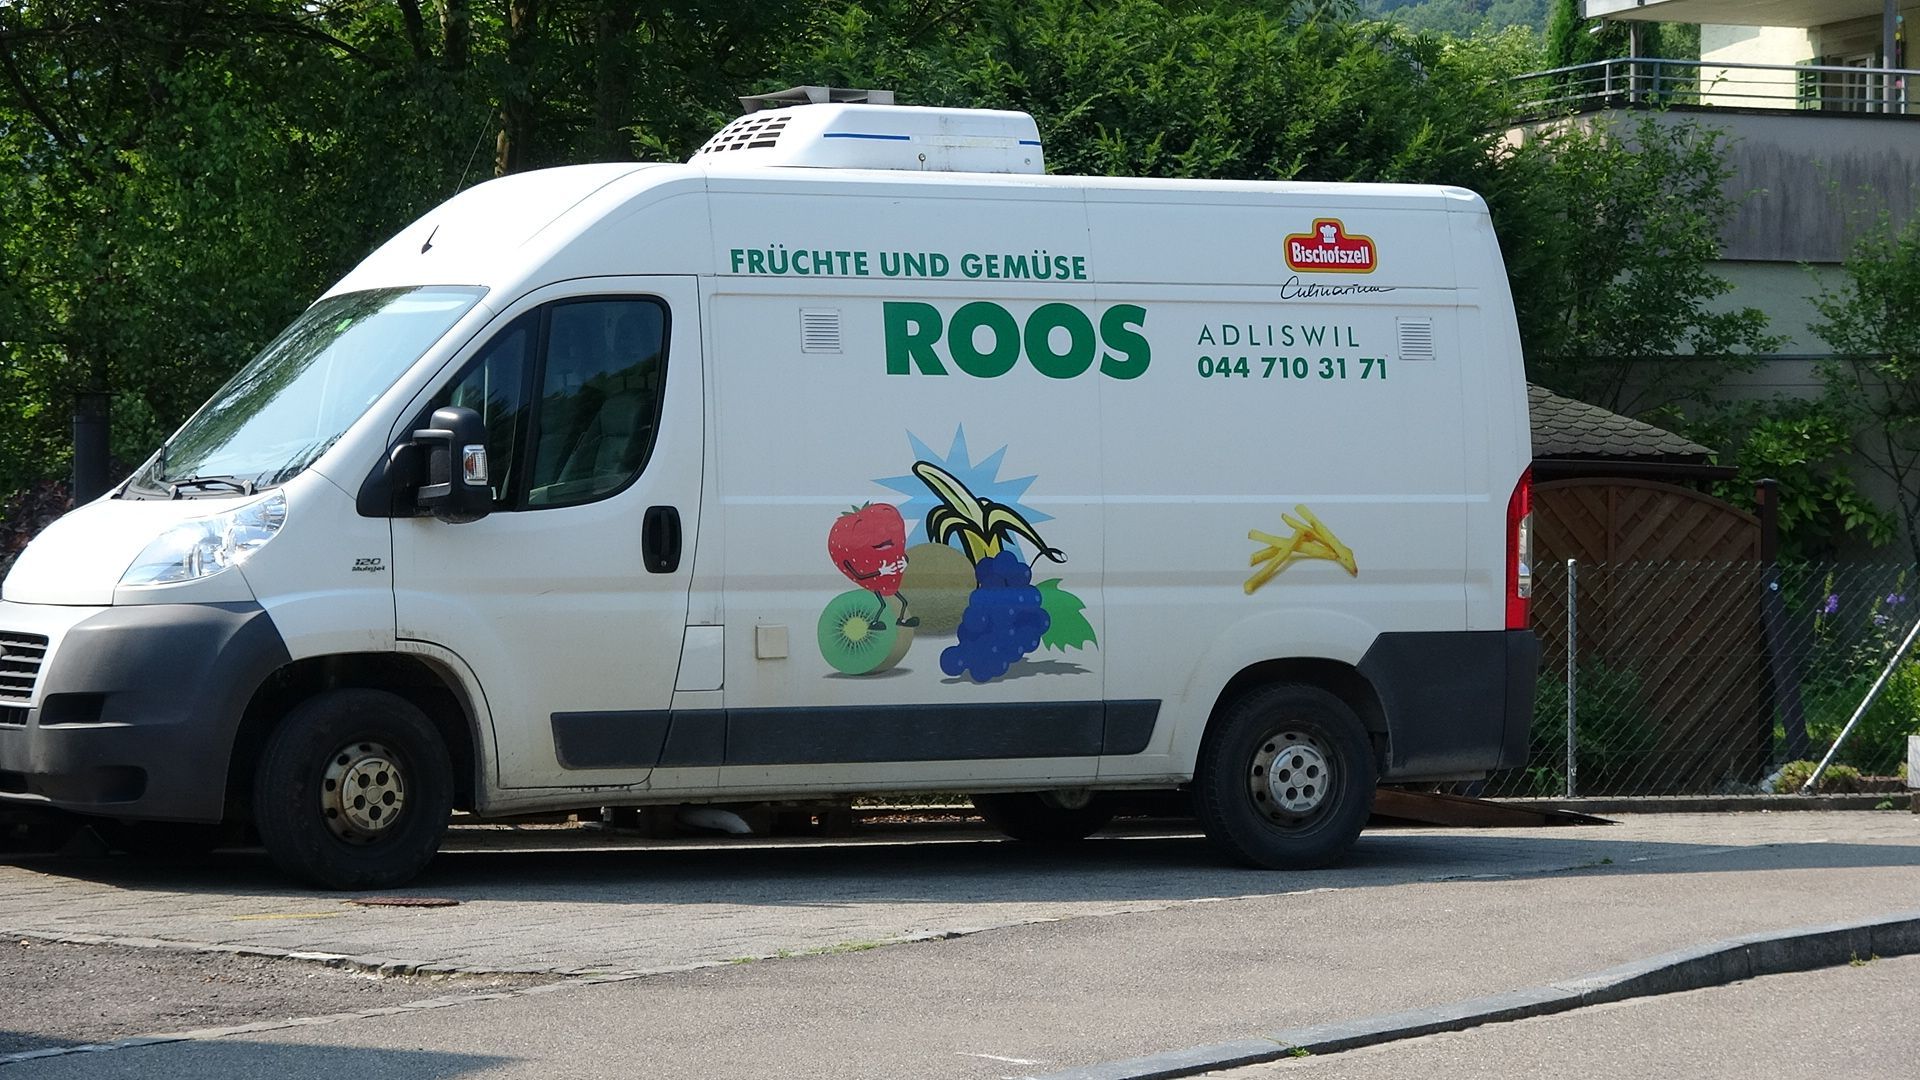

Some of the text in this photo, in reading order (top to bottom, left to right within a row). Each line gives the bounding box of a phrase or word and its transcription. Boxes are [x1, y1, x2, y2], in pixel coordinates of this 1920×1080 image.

[730, 244, 1087, 280] FRÜCHTE UND GEMÜSE
[1291, 241, 1370, 264] Bischofszell
[1281, 275, 1396, 299] Culinarium
[882, 301, 1152, 380] ROOS
[1197, 324, 1359, 347] ADLISWIL
[1197, 355, 1387, 381] 044 710 31 71
